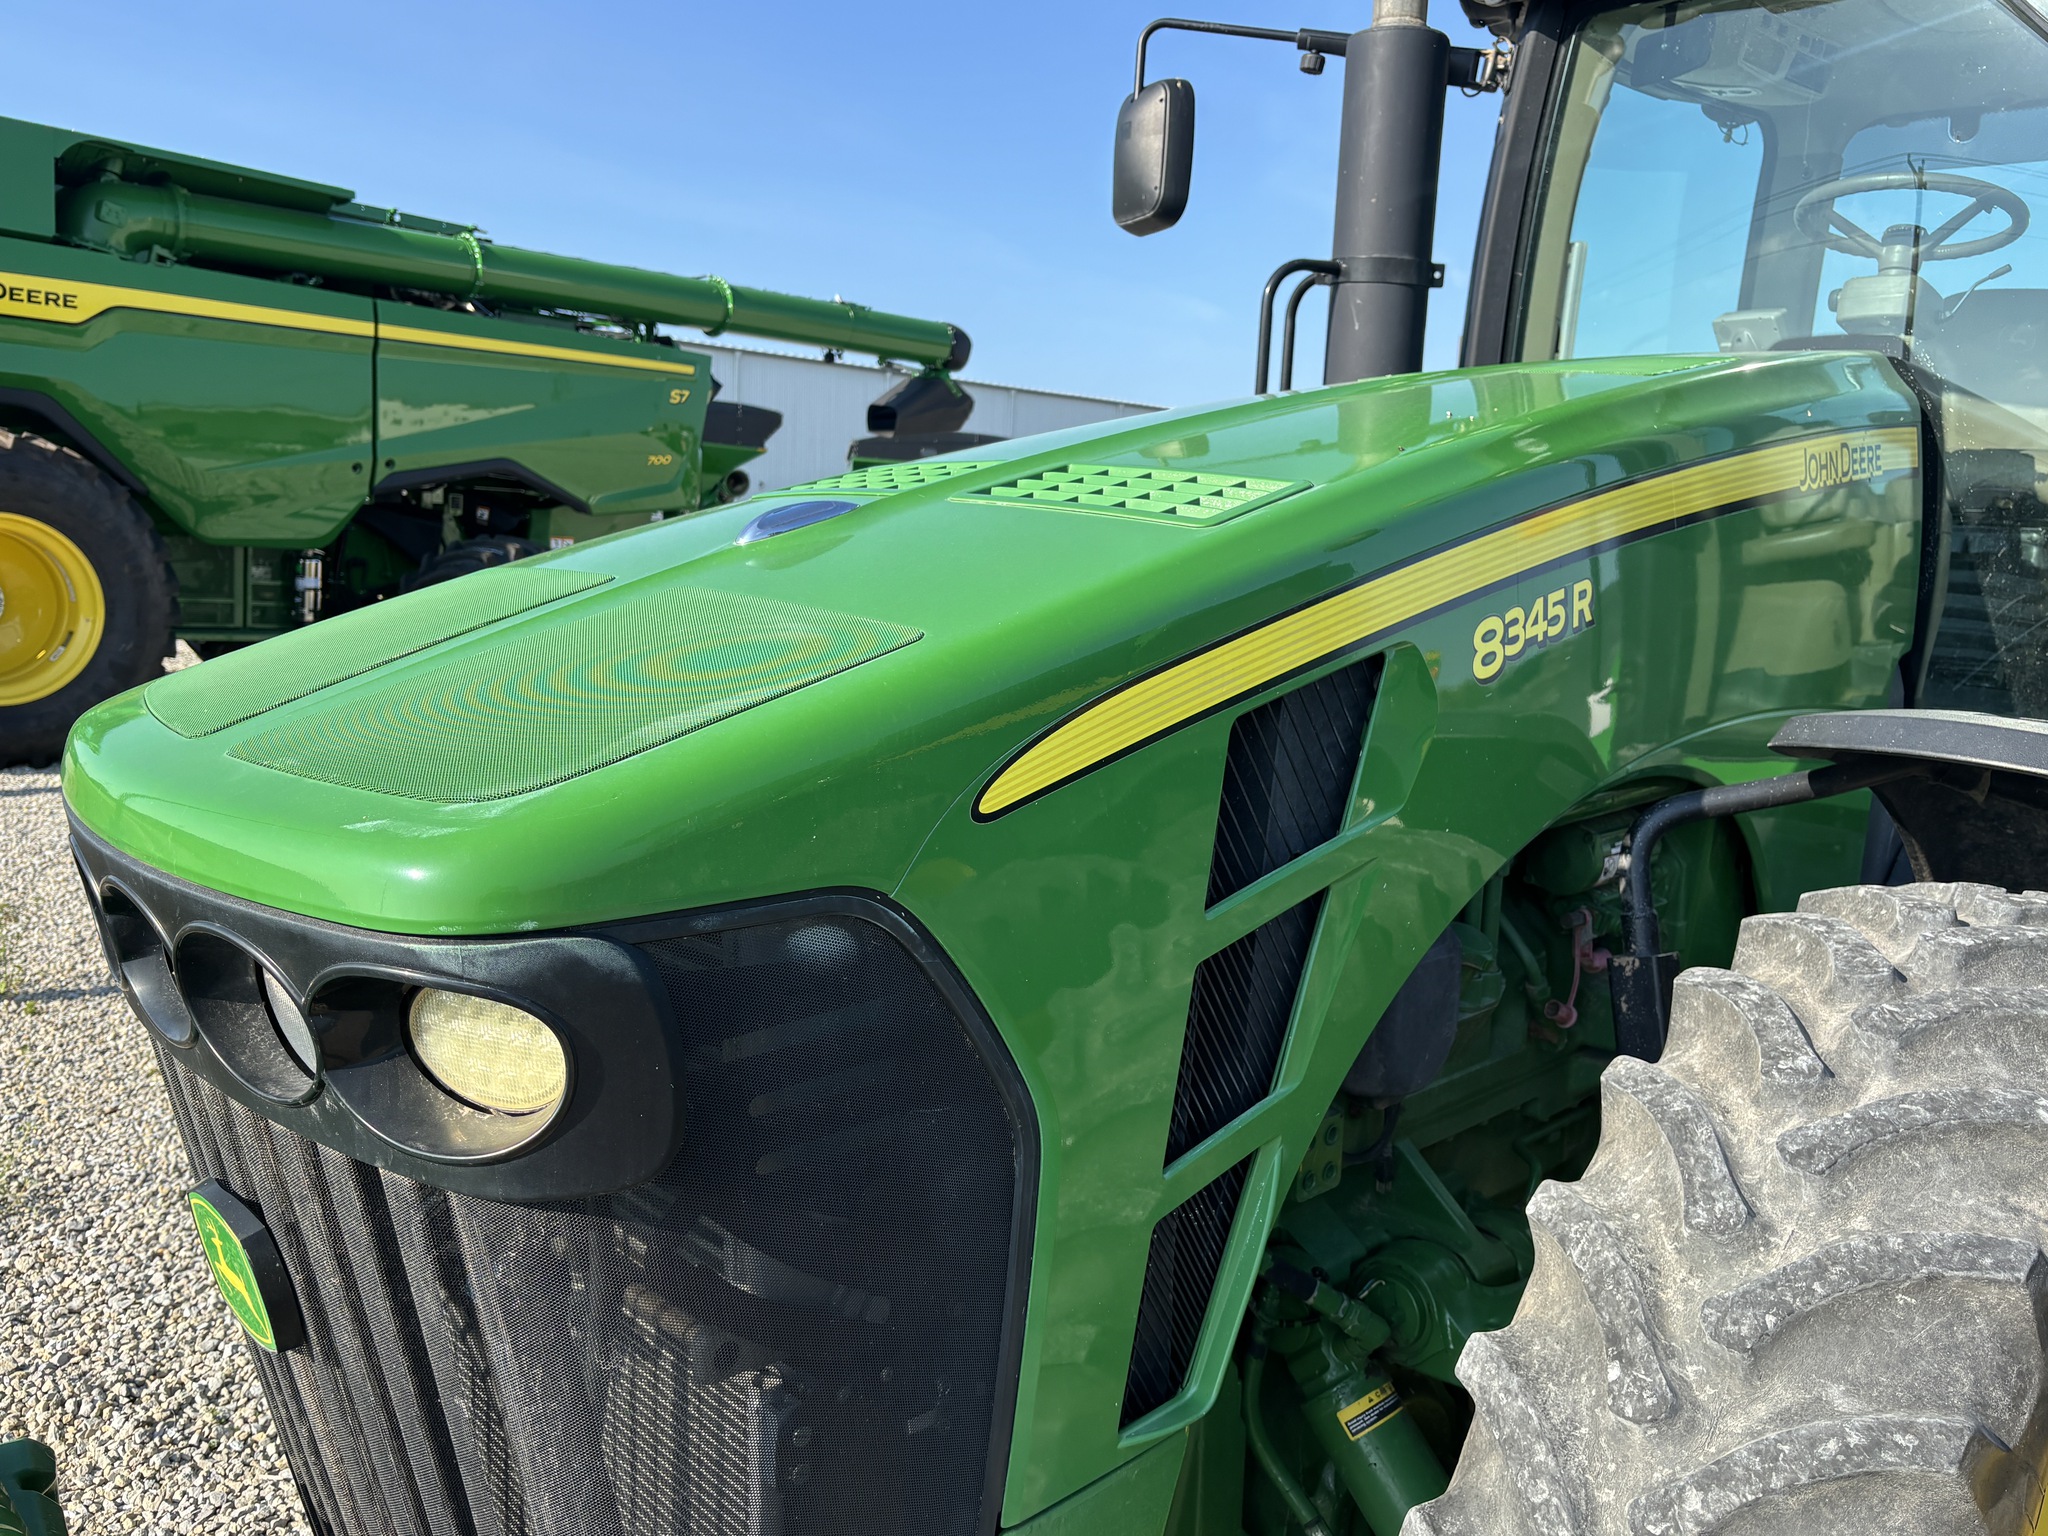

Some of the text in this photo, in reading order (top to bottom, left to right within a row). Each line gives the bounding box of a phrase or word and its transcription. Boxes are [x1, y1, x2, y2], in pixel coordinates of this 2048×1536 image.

[669, 389, 690, 404] S7
[647, 454, 672, 466] 700
[1800, 442, 1883, 490] JOHN DEERE
